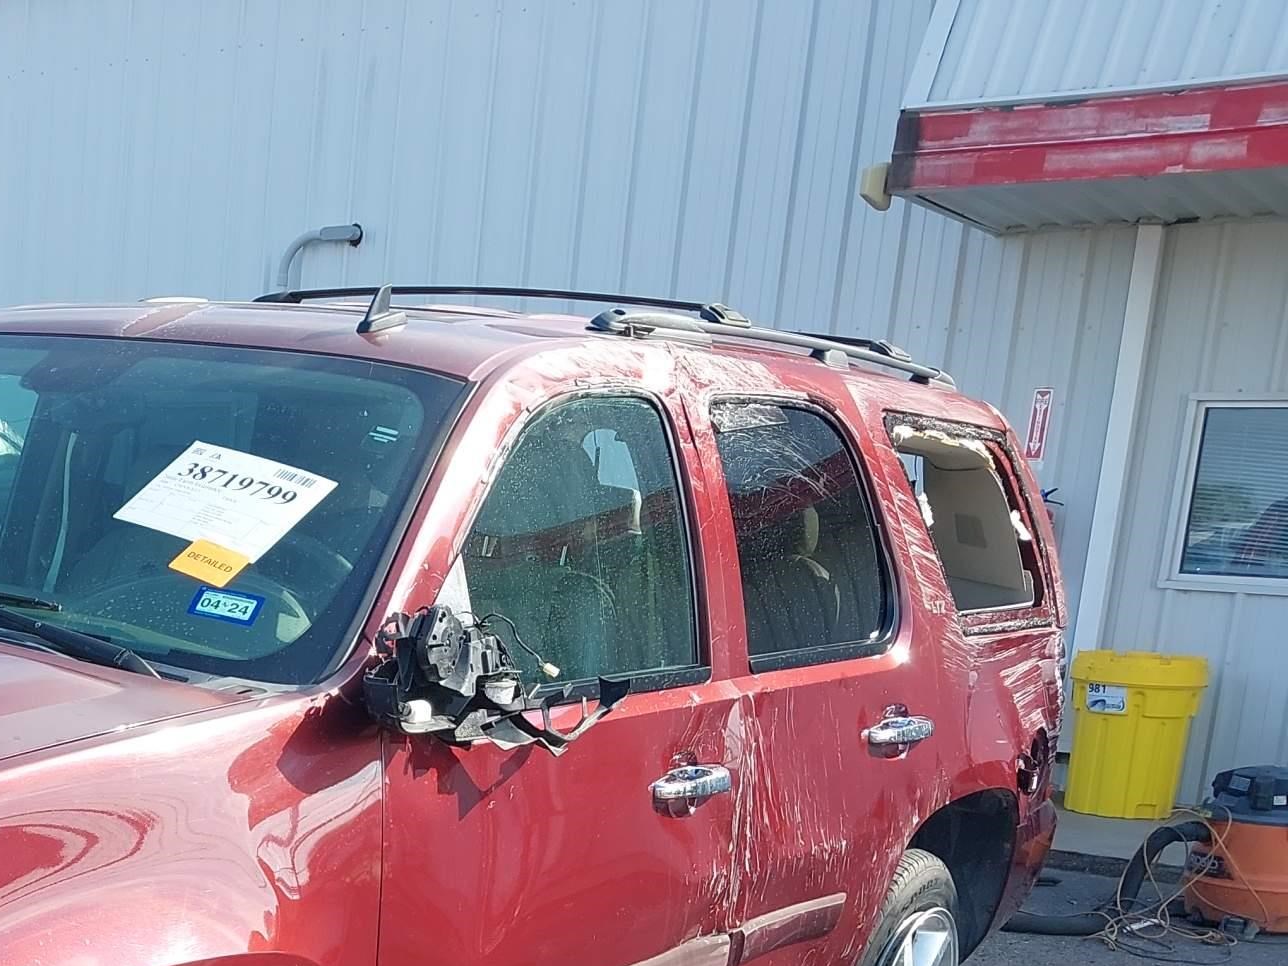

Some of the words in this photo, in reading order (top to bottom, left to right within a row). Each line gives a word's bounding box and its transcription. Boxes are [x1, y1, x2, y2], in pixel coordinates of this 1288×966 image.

[177, 462, 297, 505] 38719799
[187, 551, 233, 573] DETAILED
[200, 598, 221, 610] 04
[227, 603, 250, 615] 24
[1088, 682, 1106, 694] 981
